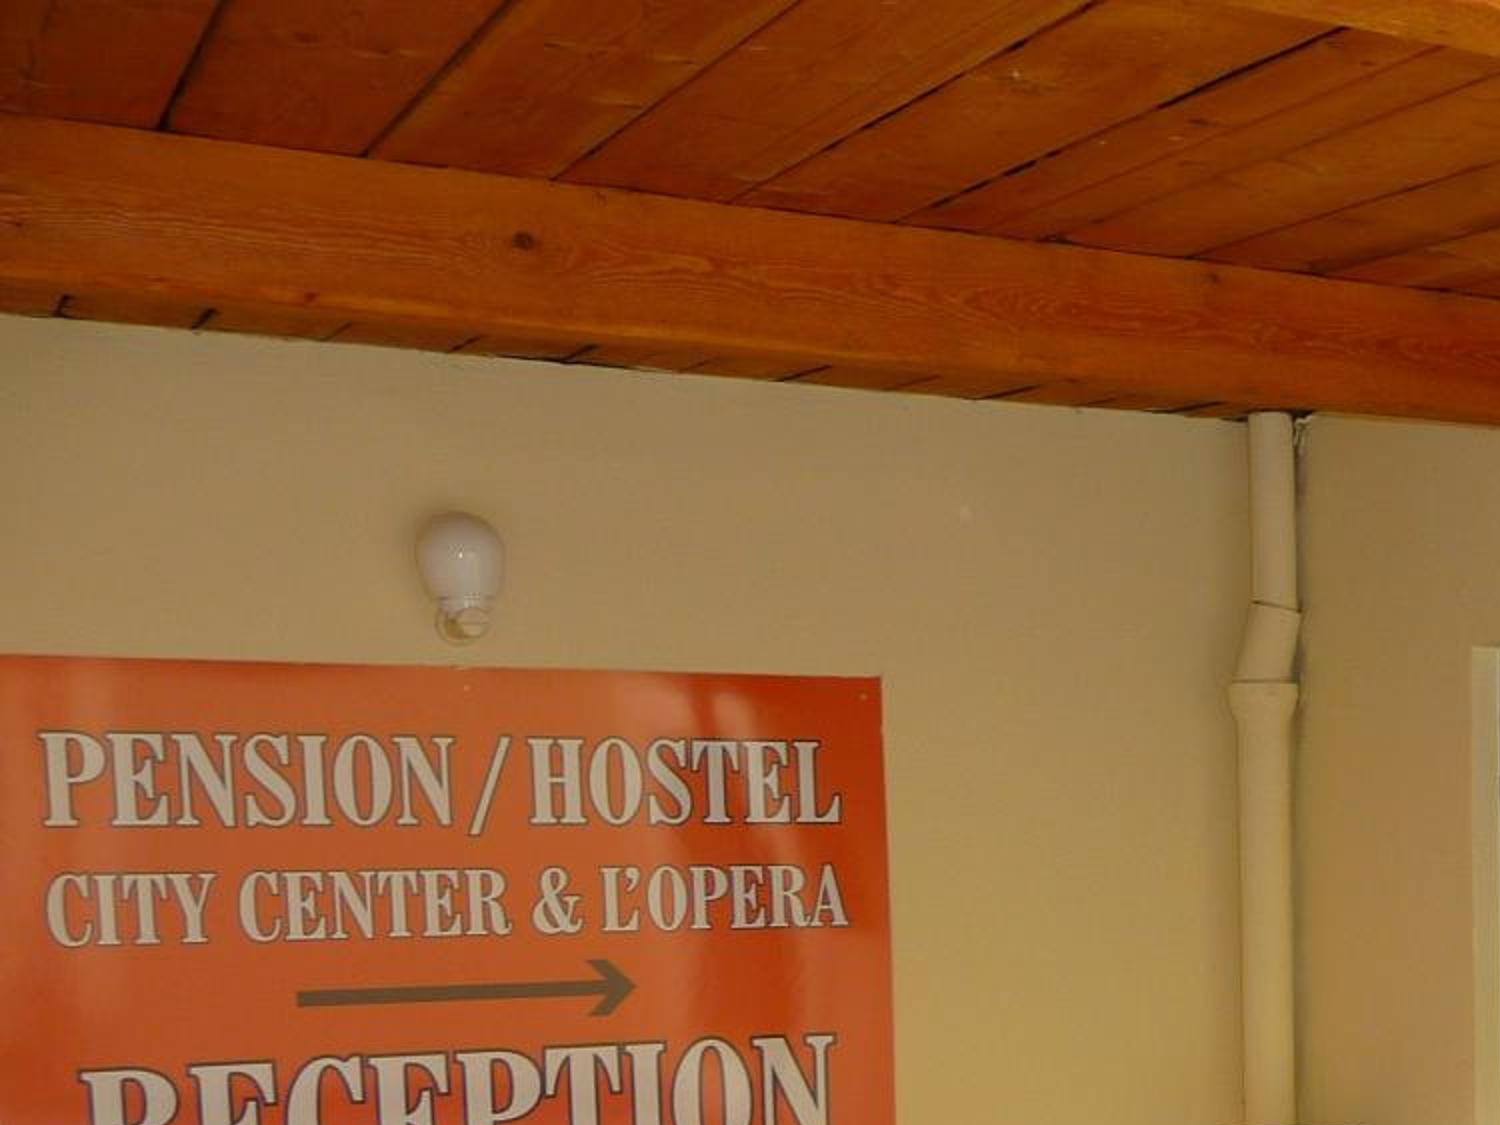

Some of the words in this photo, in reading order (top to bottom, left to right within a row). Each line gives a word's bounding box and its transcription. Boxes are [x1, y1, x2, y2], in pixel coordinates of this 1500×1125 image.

[38, 730, 456, 828] PENSION
[468, 735, 513, 836] /
[527, 736, 843, 825] HOSTEL
[45, 870, 217, 948] CITY
[238, 868, 512, 942] CENTER
[532, 866, 585, 935] &
[599, 863, 850, 932] L’OPERA
